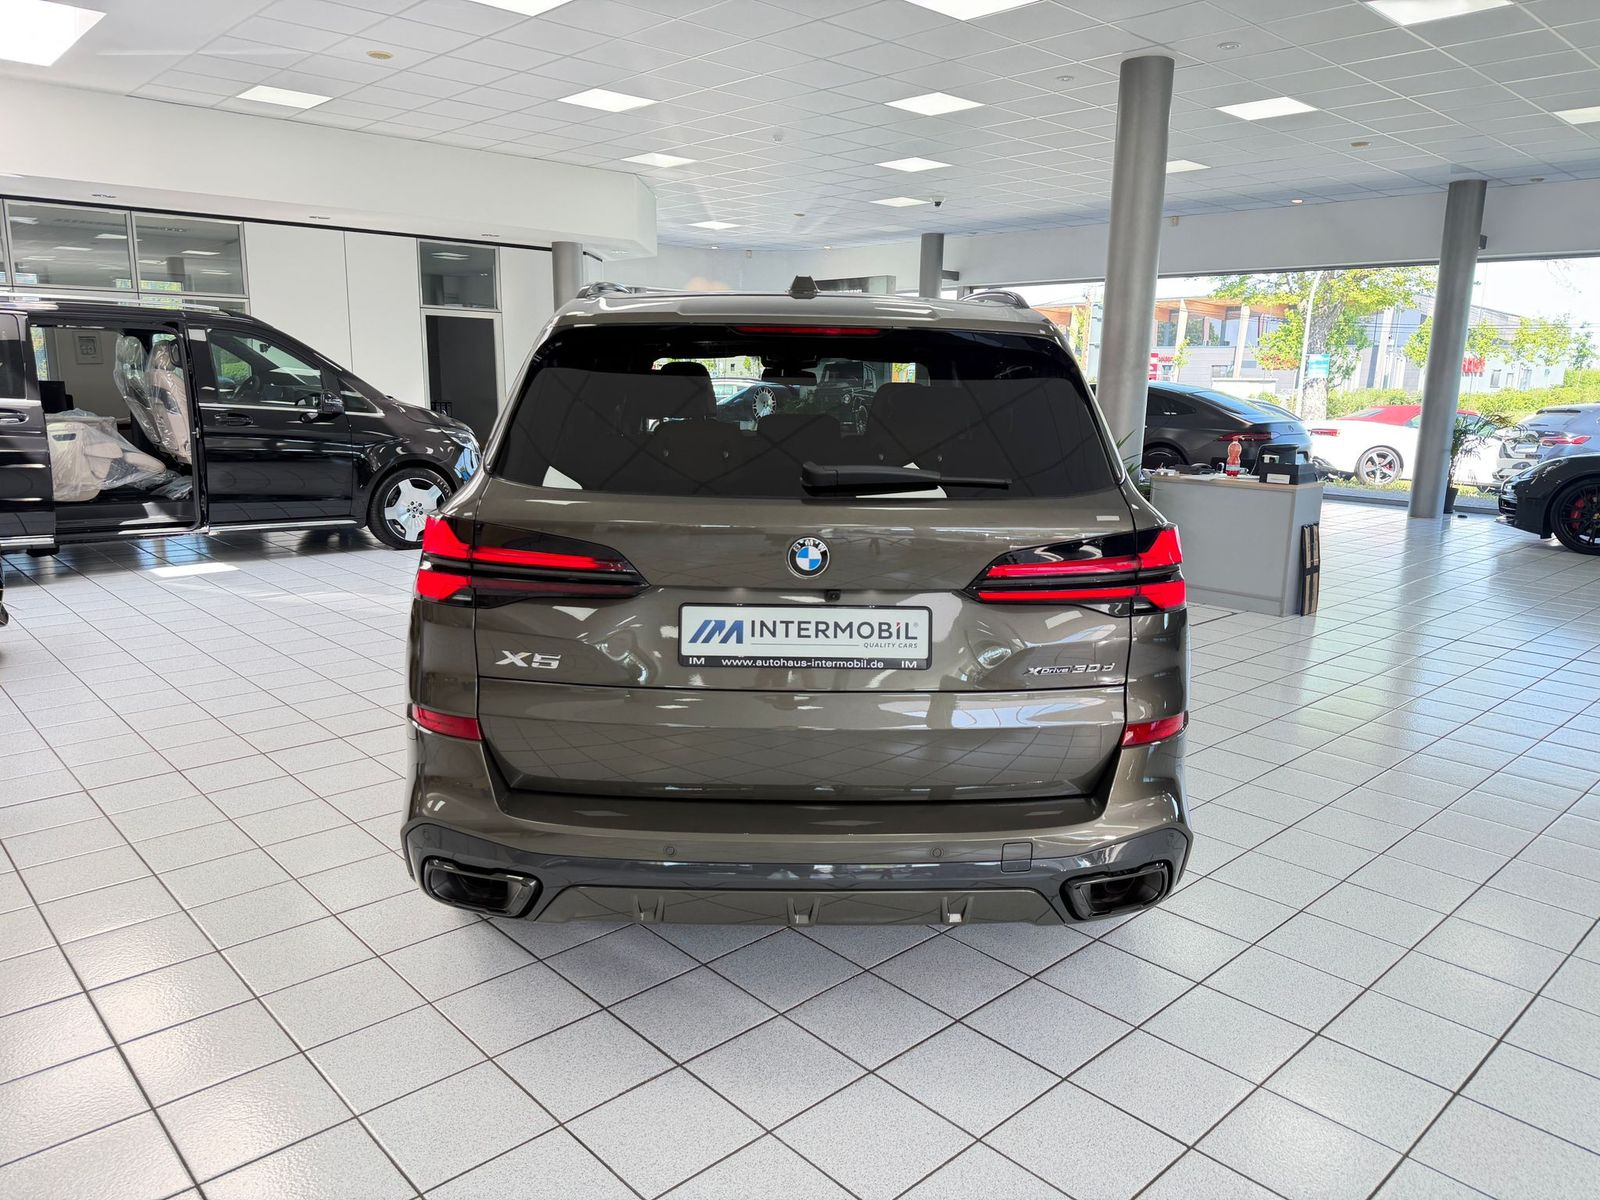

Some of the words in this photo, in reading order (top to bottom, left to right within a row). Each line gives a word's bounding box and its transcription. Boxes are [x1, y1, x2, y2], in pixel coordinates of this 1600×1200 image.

[792, 539, 828, 552] BMW
[495, 650, 561, 669] X5
[688, 657, 705, 665] IM
[721, 658, 884, 669] www.autohaus-intermobil.de
[901, 660, 917, 668] IM
